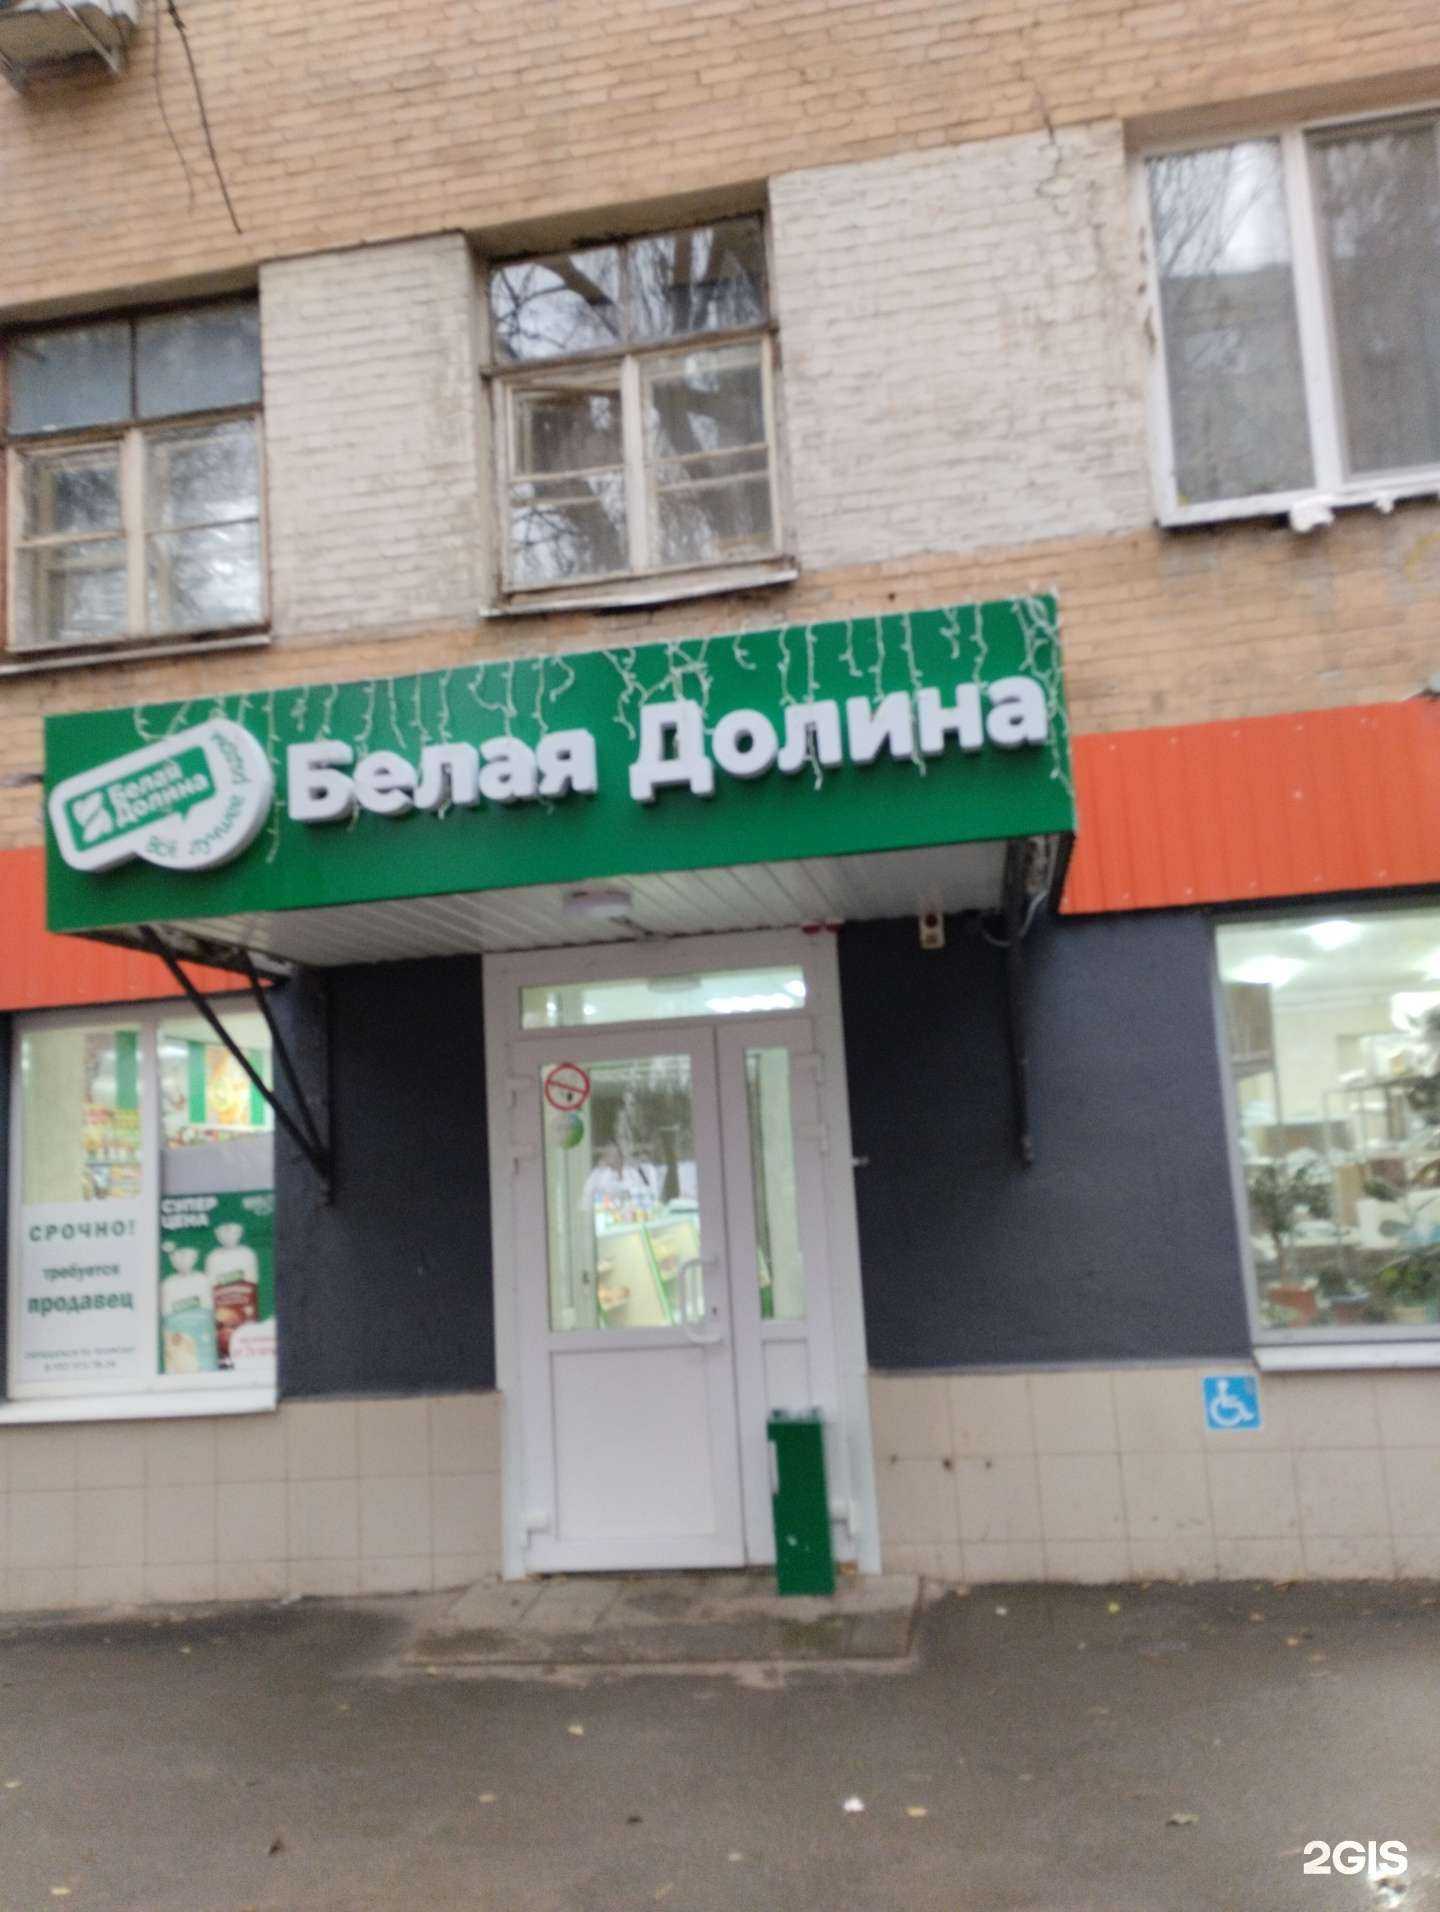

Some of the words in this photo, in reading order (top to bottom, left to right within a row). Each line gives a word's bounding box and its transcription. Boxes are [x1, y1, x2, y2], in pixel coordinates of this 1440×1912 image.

[287, 729, 597, 823] Белая
[630, 676, 1047, 802] Долина
[29, 1220, 136, 1242] СРОЧНО!
[43, 1263, 121, 1282] требуется
[27, 1293, 134, 1316] продавец
